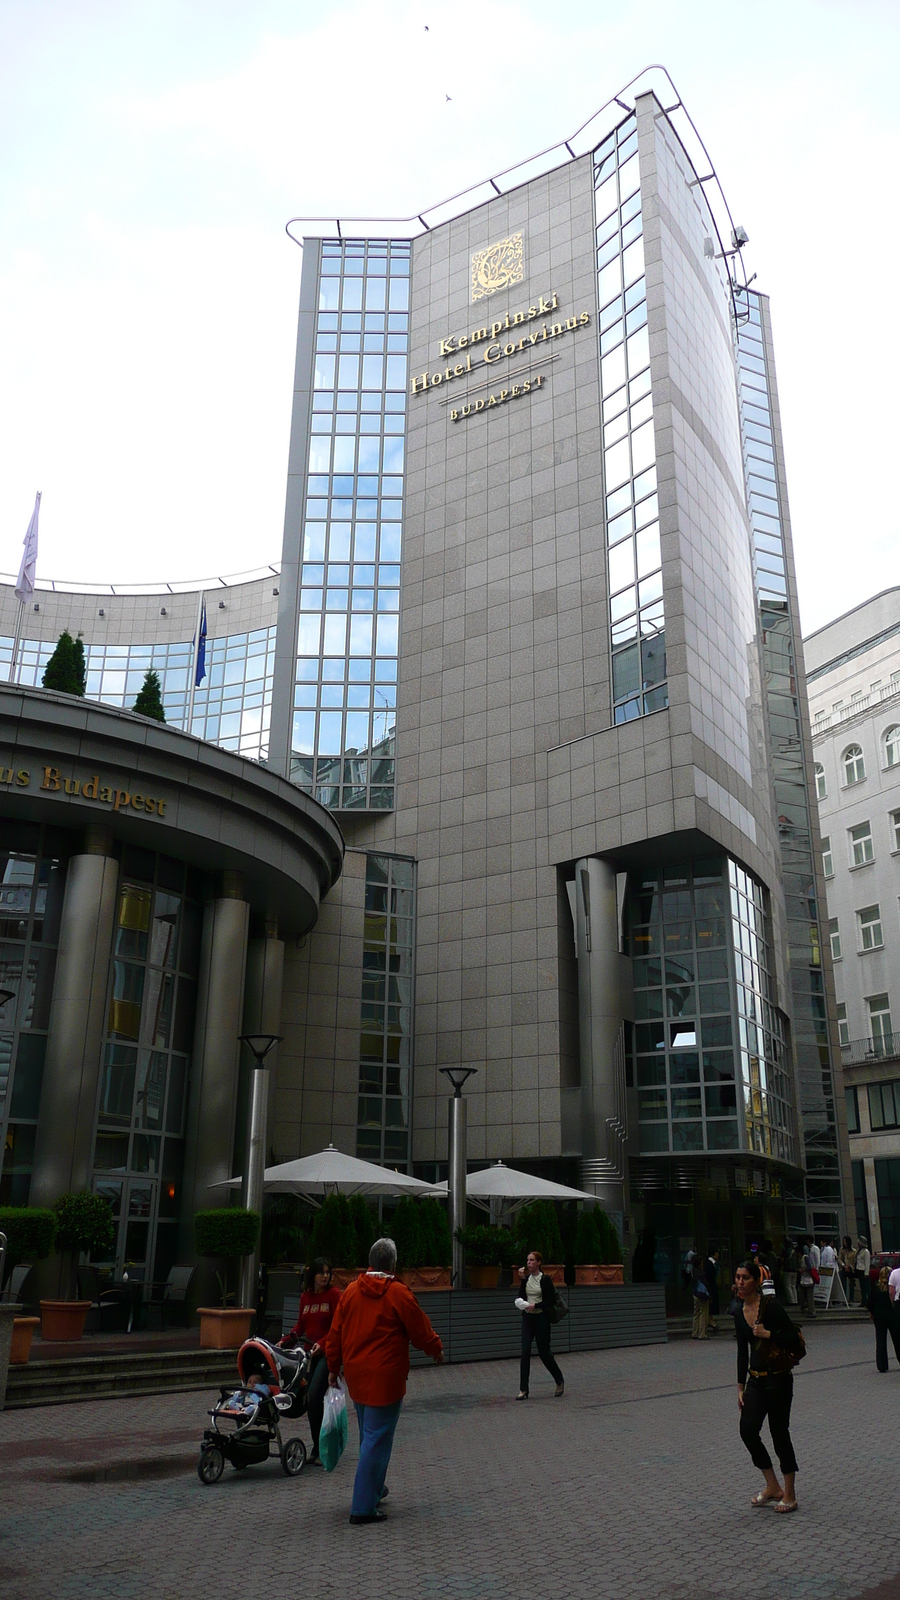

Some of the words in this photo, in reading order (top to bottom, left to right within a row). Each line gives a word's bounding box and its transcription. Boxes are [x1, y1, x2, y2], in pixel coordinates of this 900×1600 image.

[410, 354, 472, 395] Hotel
[484, 311, 590, 363] Corvinus
[438, 292, 558, 357] Kempinski
[450, 375, 544, 421] BUDAPEST
[39, 765, 167, 817] Budapest
